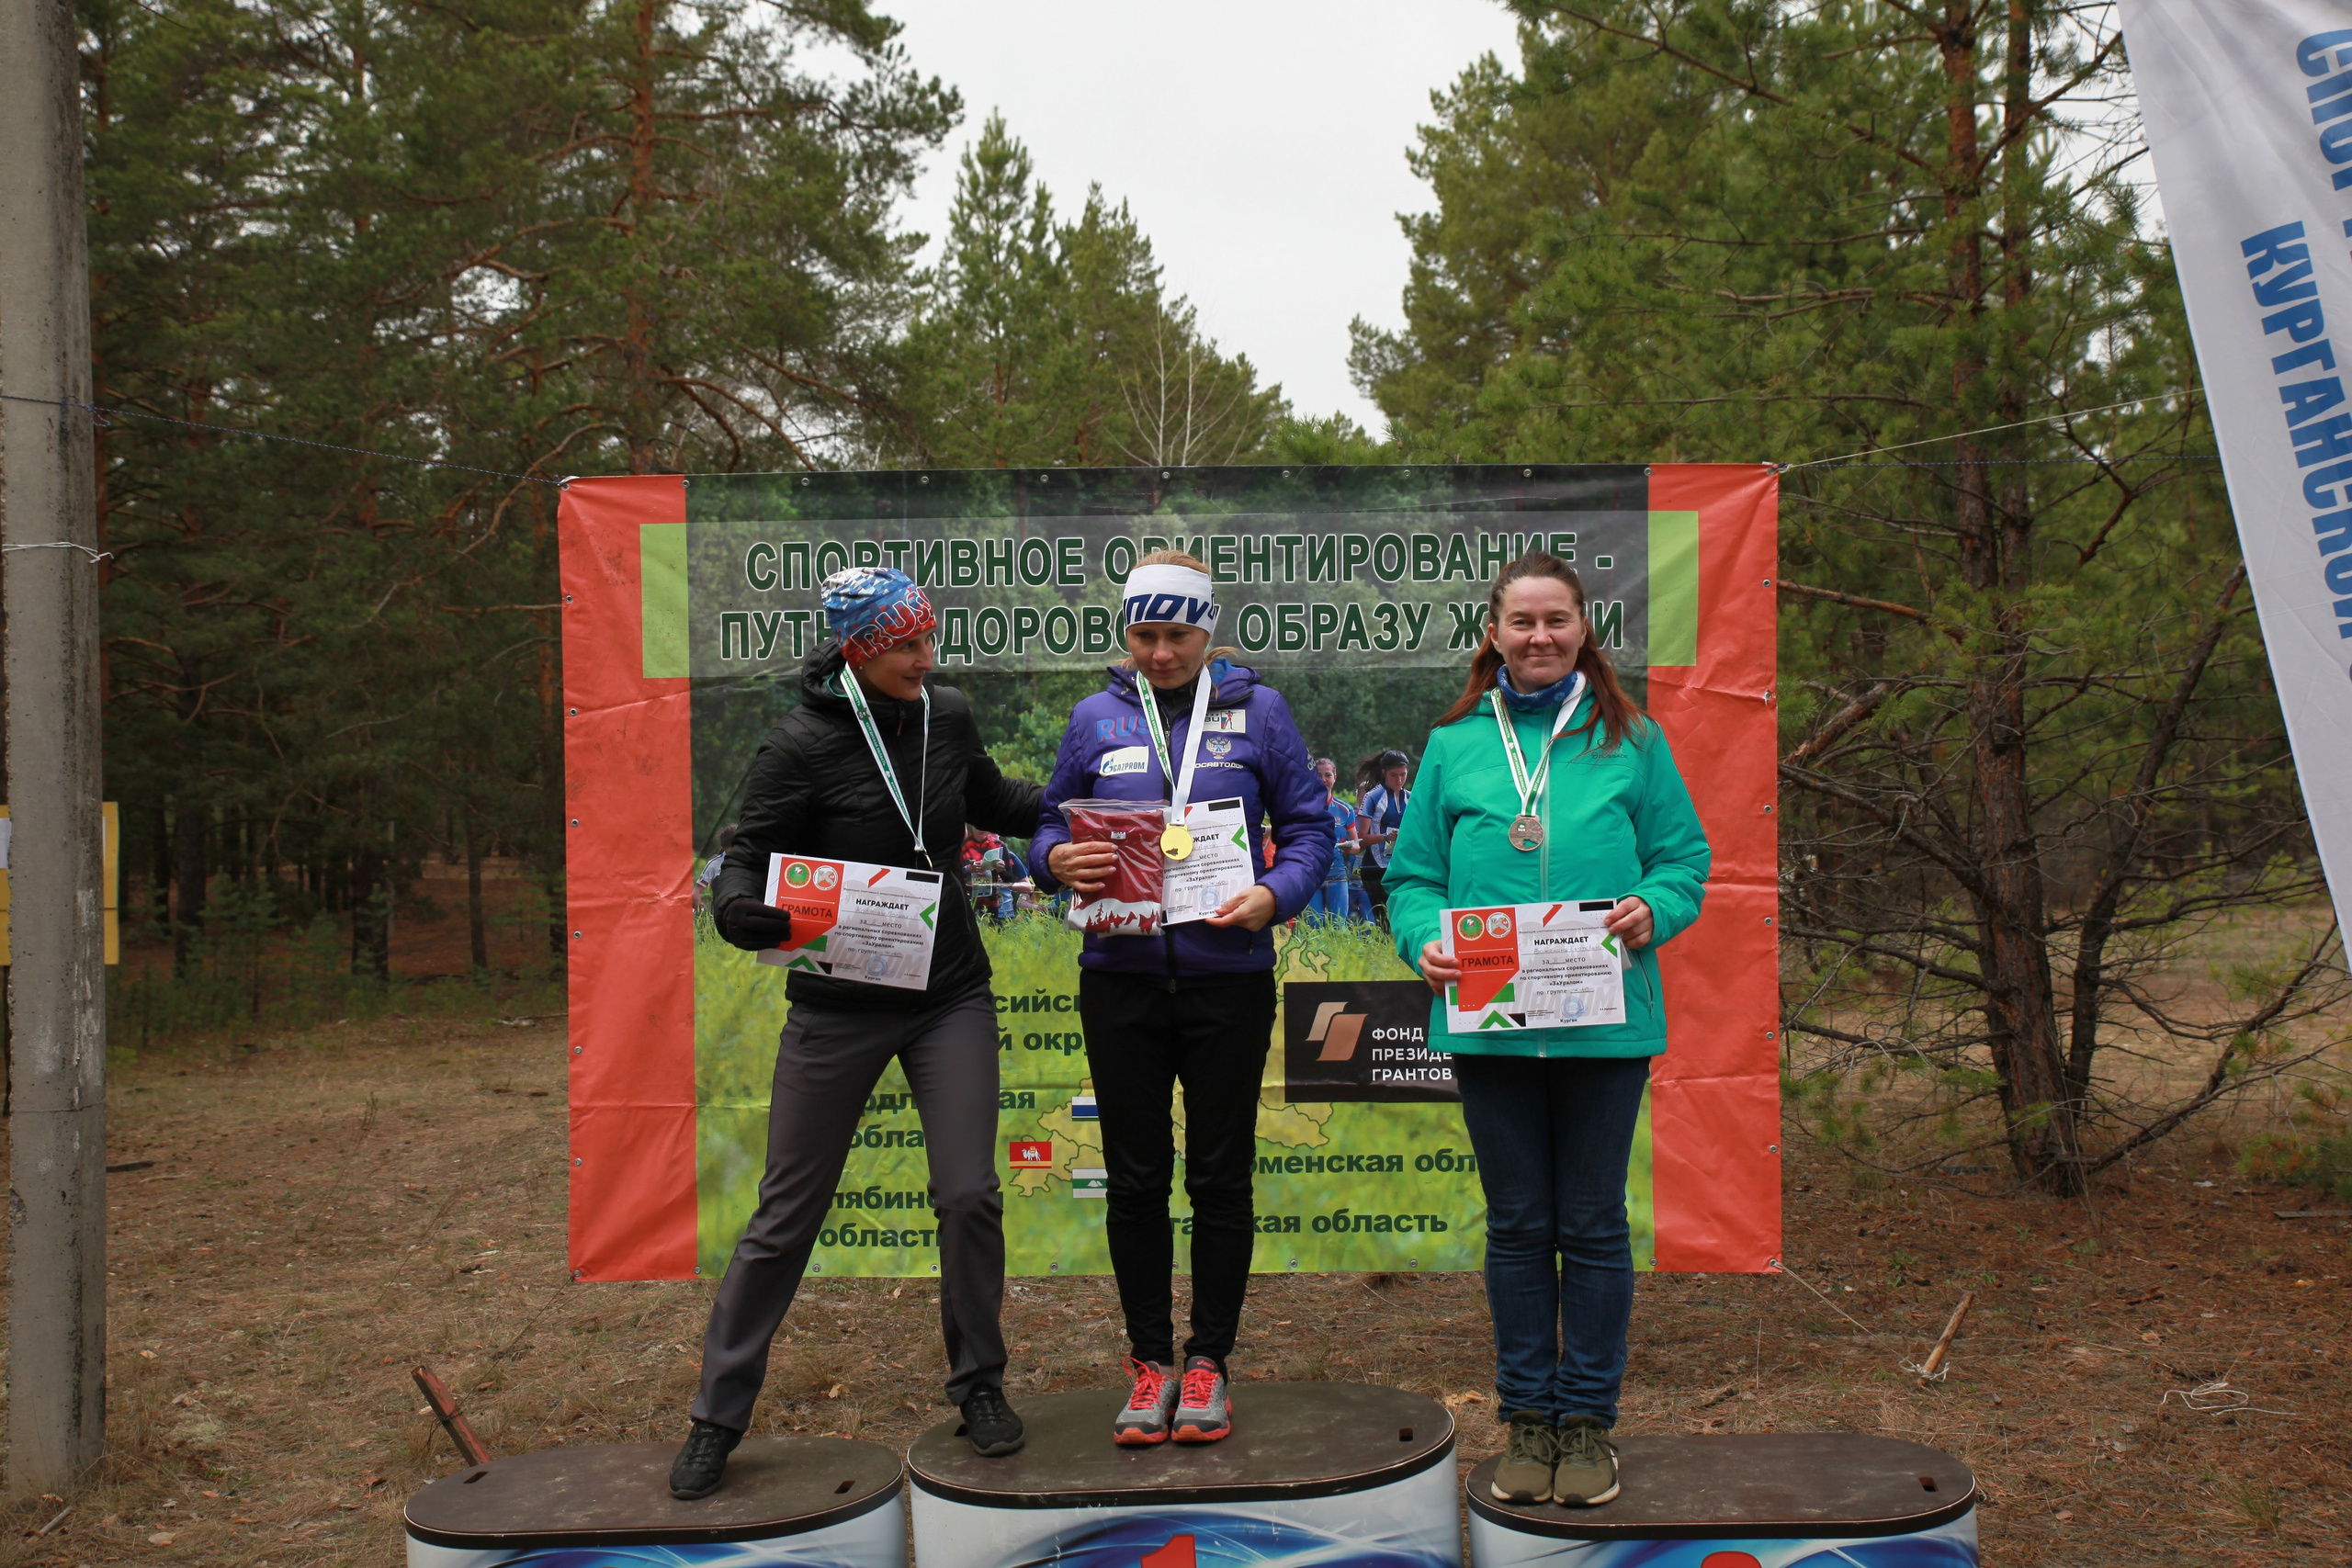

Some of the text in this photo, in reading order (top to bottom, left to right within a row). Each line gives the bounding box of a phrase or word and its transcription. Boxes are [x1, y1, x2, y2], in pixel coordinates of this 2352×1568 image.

[1238, 602, 1432, 653] ОБРАЗУ
[1113, 761, 1146, 773] GAZPROM
[1194, 761, 1244, 770] ОСАВТОДОР
[855, 898, 910, 910] НАГРАЖДАЕТ
[782, 904, 833, 919] ГРАМОТА
[1534, 936, 1589, 945] НАГРАЖДАЕТ
[1462, 955, 1514, 967] ГРАМОТА
[1372, 1028, 1424, 1042] ФОНД
[1372, 1068, 1453, 1081] ГРАНТОВ
[1311, 1208, 1449, 1234] область
